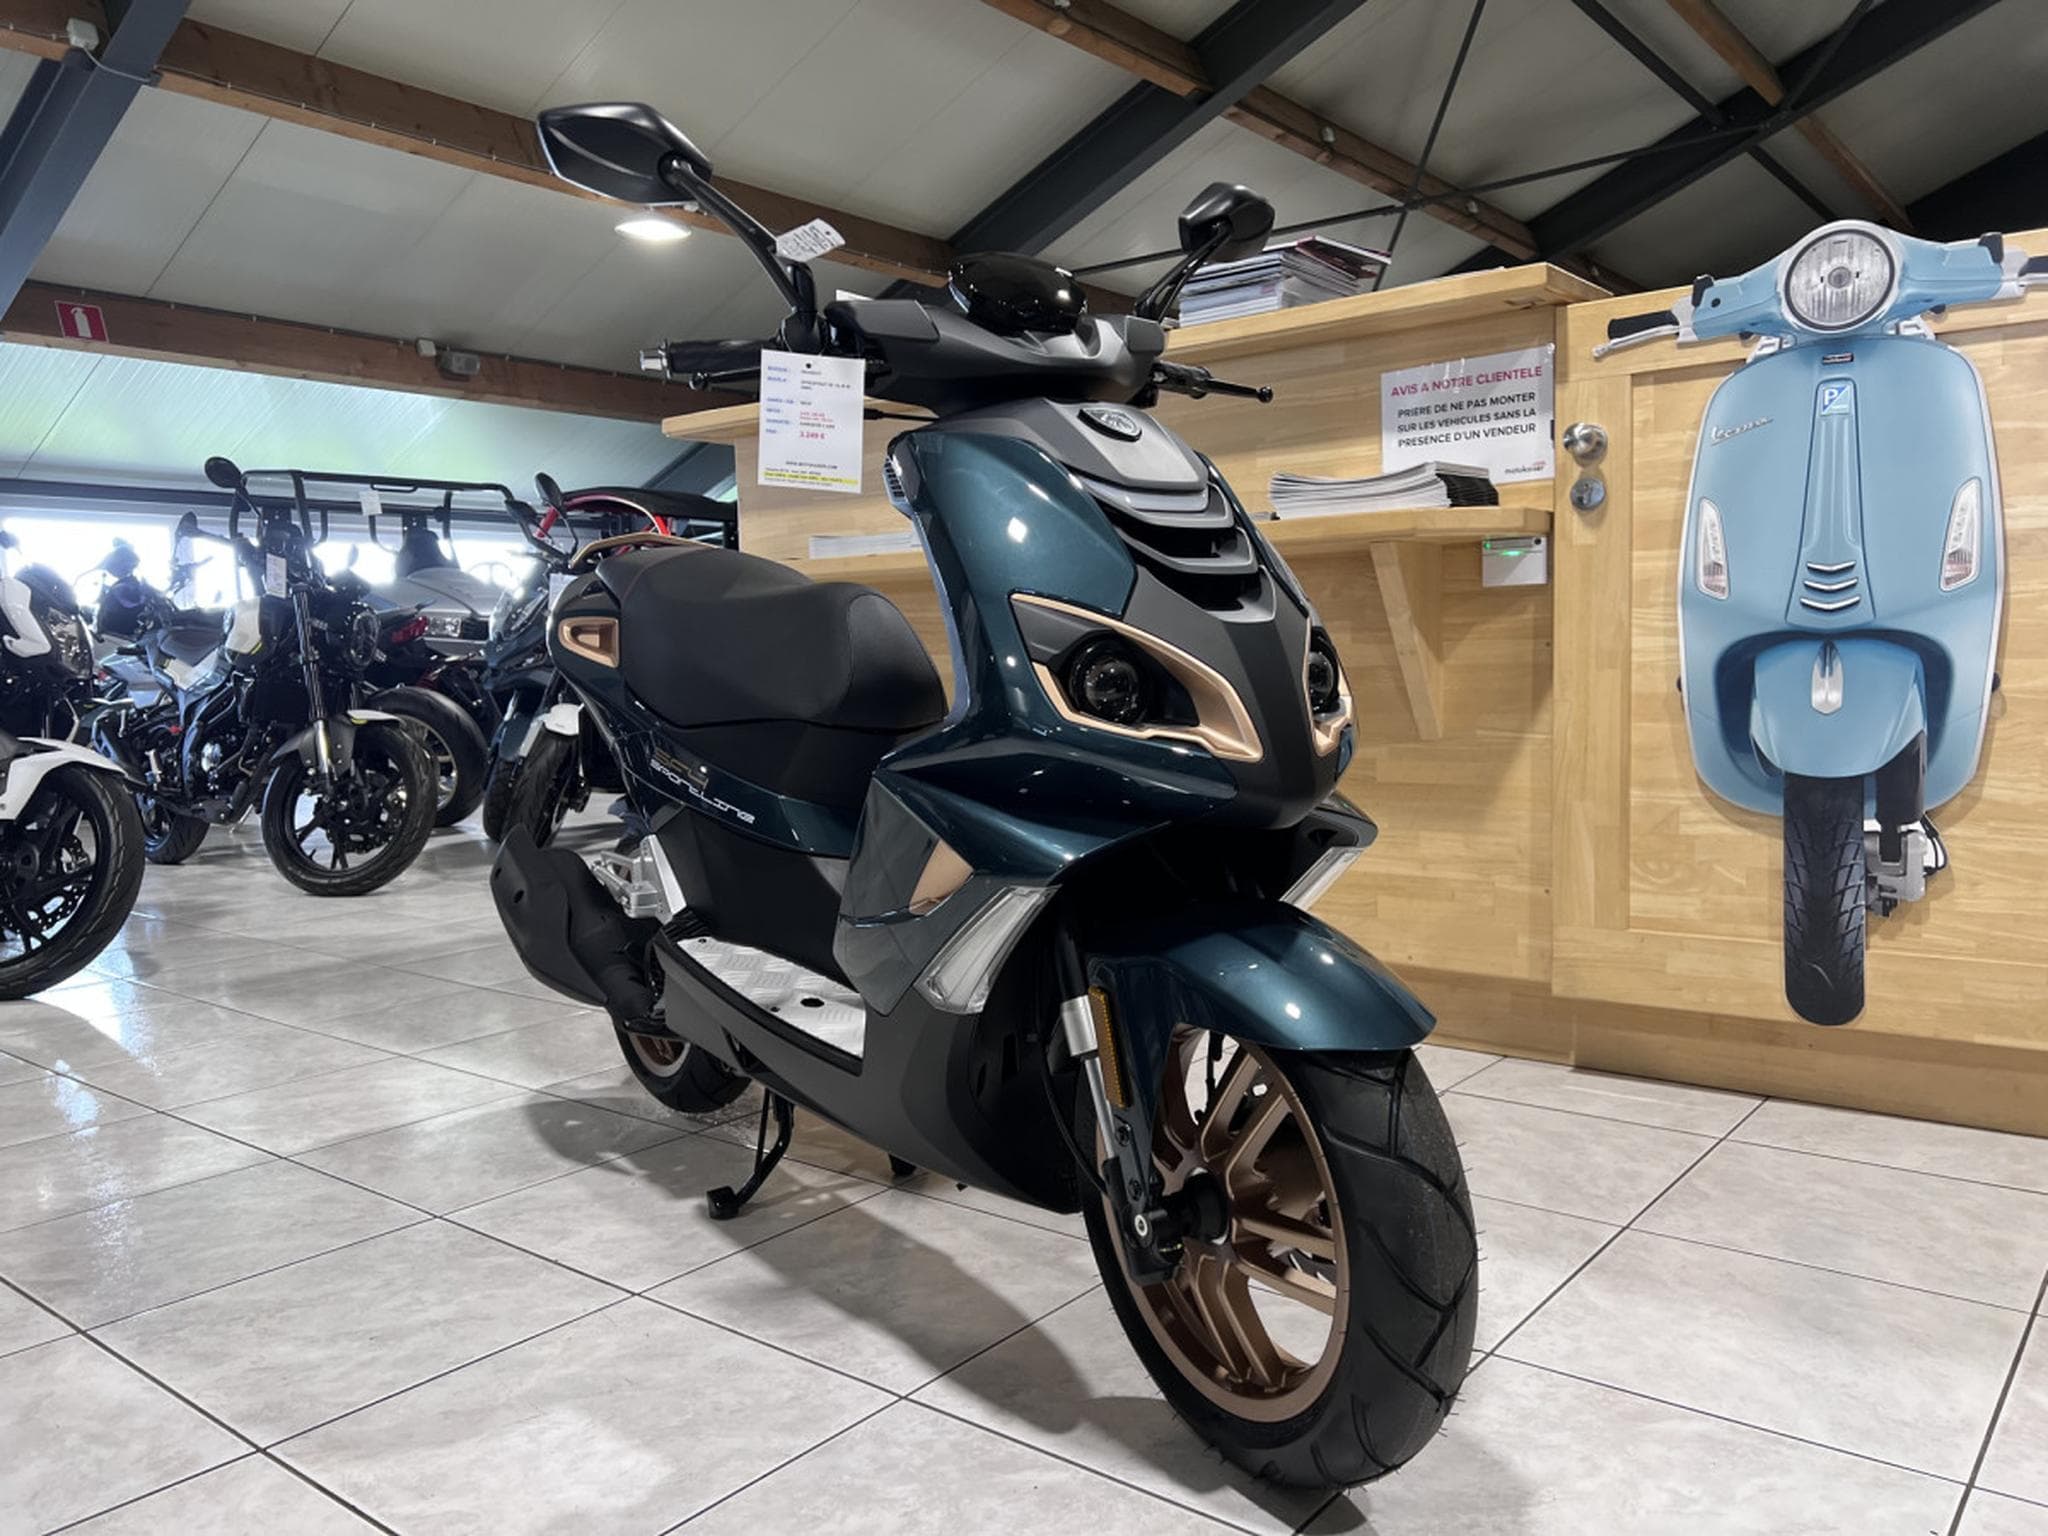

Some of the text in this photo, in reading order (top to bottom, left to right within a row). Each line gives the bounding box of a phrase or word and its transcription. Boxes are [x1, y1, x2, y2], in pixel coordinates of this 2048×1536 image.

[1391, 366, 1543, 397] AVIS A NOTRE CLIENTELE
[1397, 392, 1536, 418] PRIERE DE NE PAS MONTER
[1397, 408, 1536, 433] SUR LES VEHICULES SANS LA
[1398, 423, 1536, 448] PRESENCE D'UN VENDEUR
